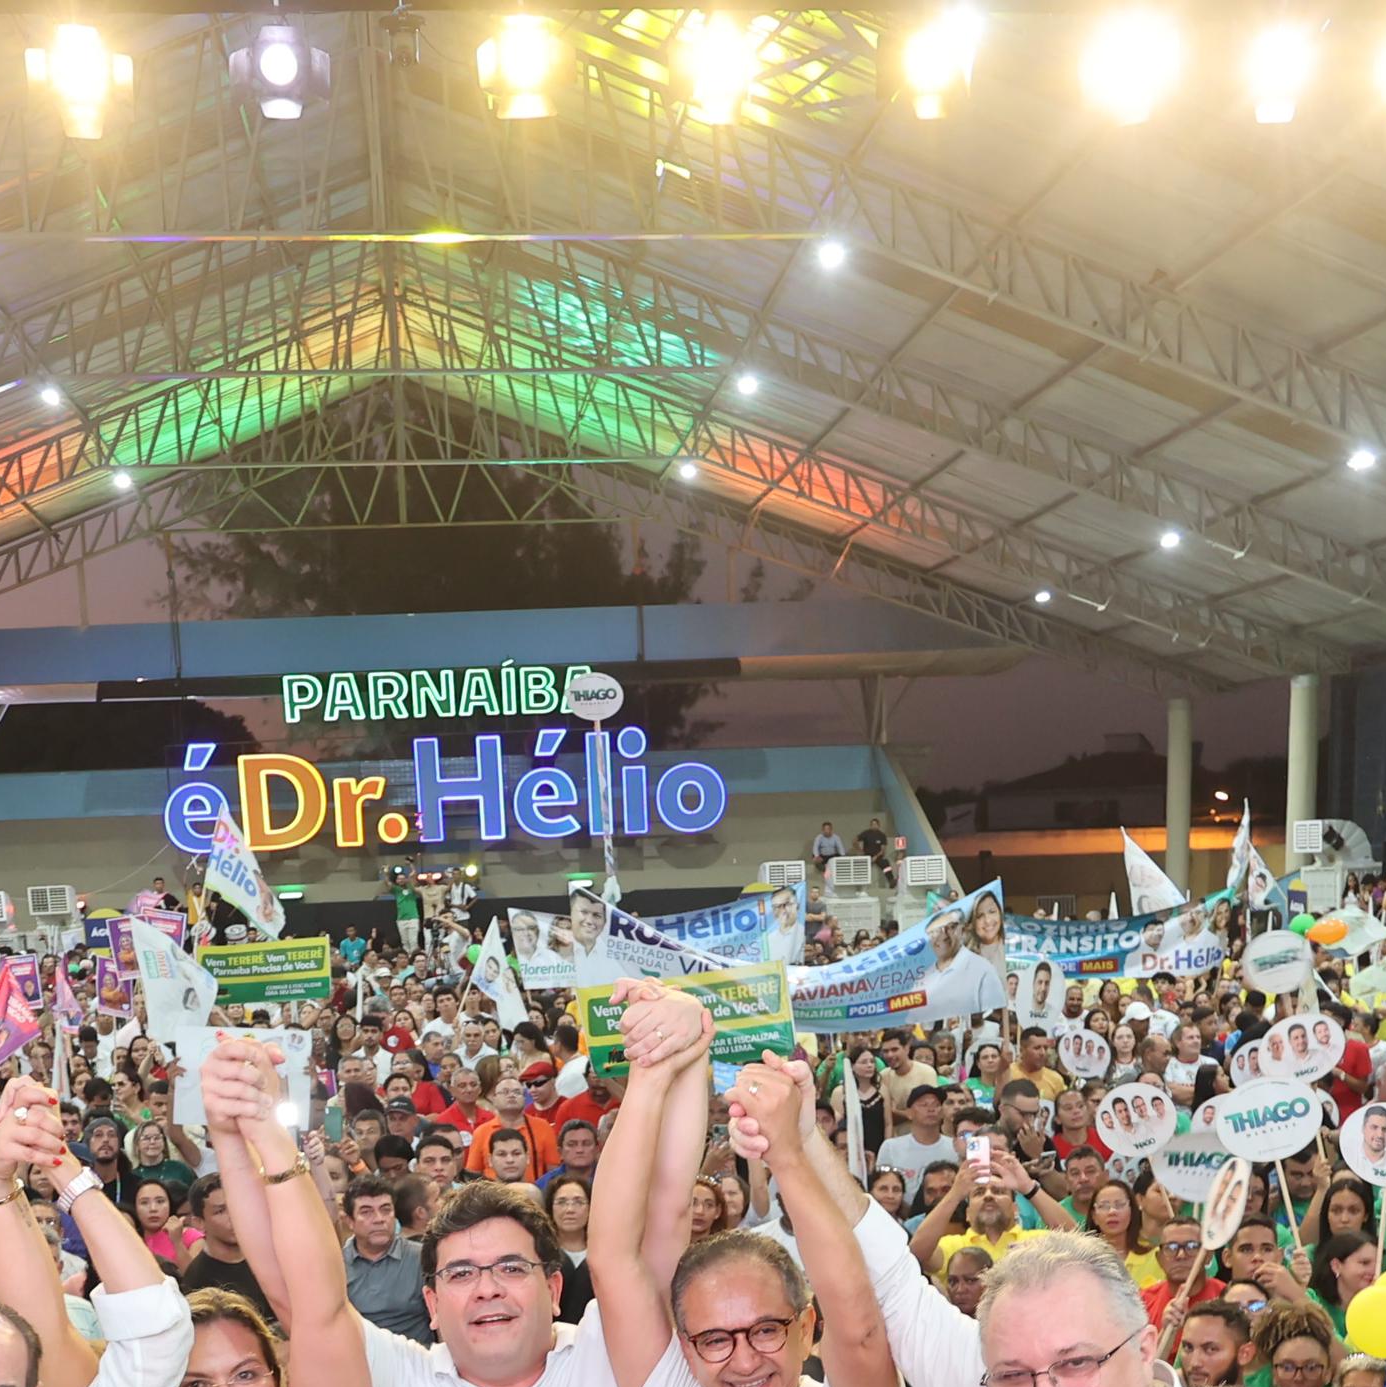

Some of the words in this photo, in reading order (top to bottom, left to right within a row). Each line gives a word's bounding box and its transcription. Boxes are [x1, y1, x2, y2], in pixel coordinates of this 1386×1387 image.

[570, 688, 617, 702] THIAGO
[606, 939, 675, 961] DEPUTADO
[205, 957, 226, 967] Vem
[266, 953, 285, 963] Vem
[606, 950, 670, 972] ESTADUAL
[1082, 960, 1114, 971] MAIS
[252, 964, 281, 974] Precisa
[283, 963, 293, 971] de
[593, 1005, 622, 1017] Vem
[714, 1004, 731, 1018] de
[849, 1003, 885, 1016] PODE
[889, 993, 923, 1010] MAIS
[733, 1031, 780, 1043] FISCALIZAR
[1224, 1097, 1311, 1134] THIAGO
